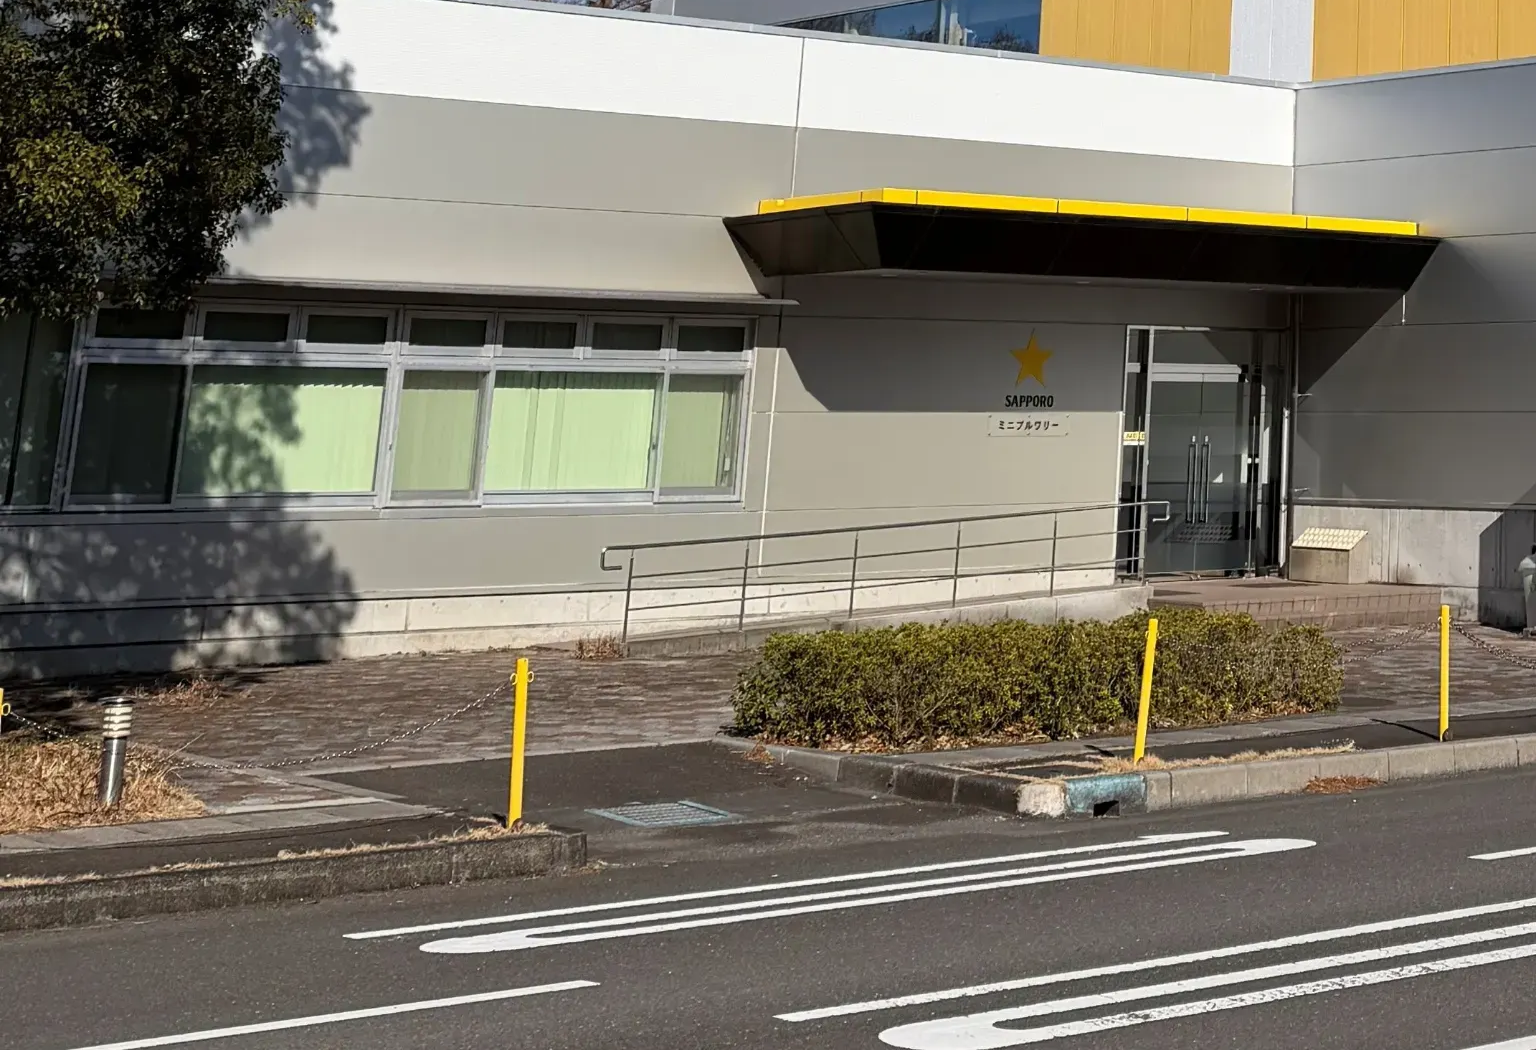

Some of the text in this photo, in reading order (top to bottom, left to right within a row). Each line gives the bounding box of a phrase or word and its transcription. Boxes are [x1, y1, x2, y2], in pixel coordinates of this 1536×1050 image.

[1005, 395, 1054, 407] SAPPORO
[998, 420, 1059, 431] ミニブルワリー
